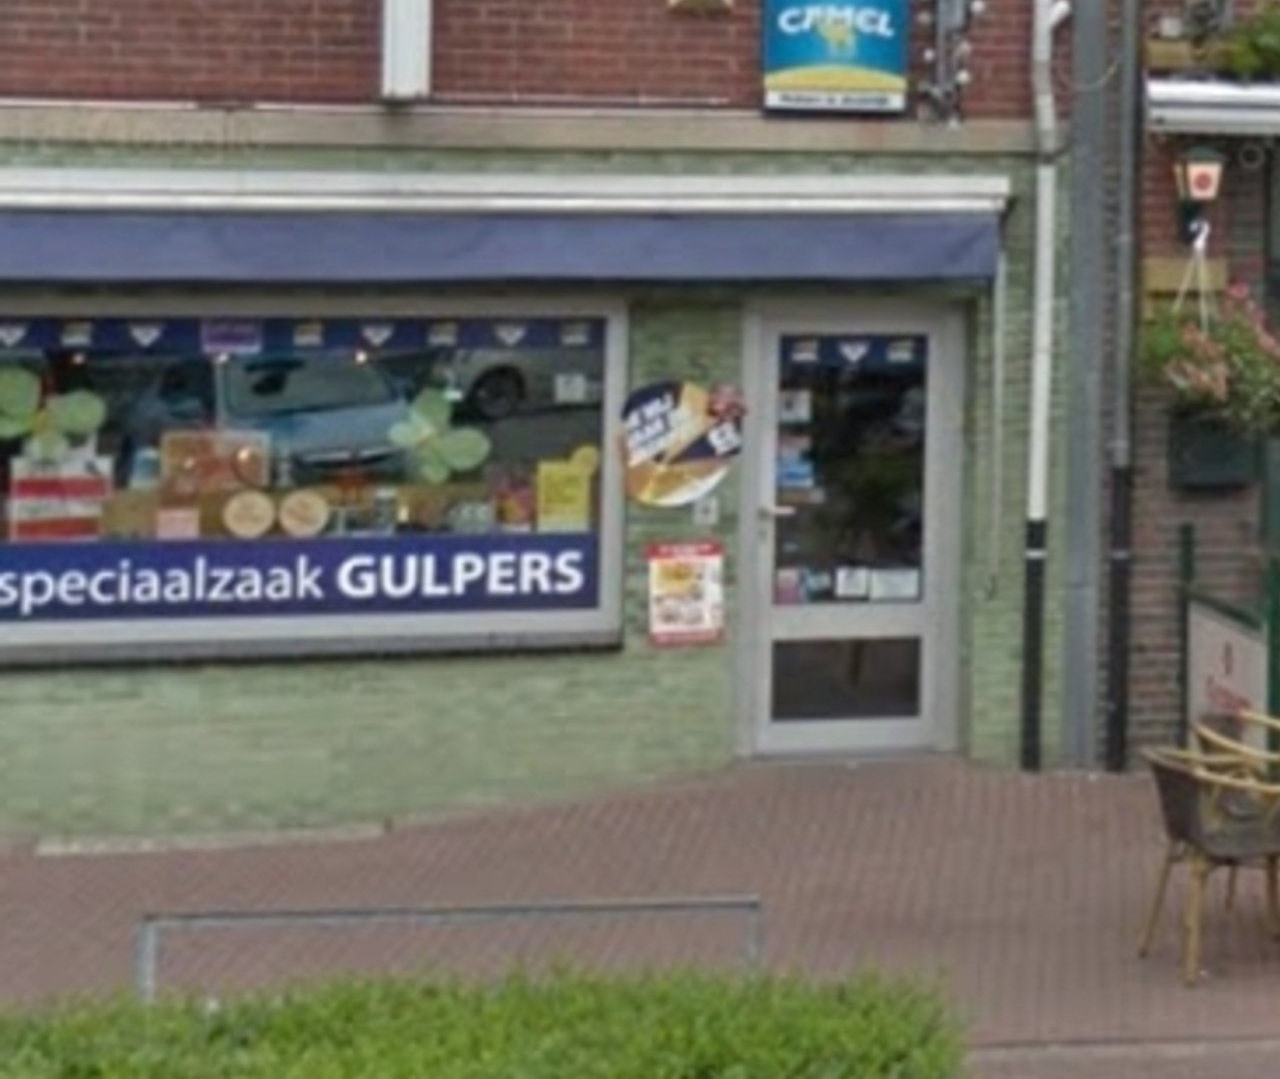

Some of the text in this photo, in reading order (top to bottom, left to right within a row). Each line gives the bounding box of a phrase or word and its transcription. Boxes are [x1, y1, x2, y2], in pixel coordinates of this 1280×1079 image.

[777, 4, 895, 38] CAMEL
[0, 550, 585, 614] speciaalzaak GULPERS
